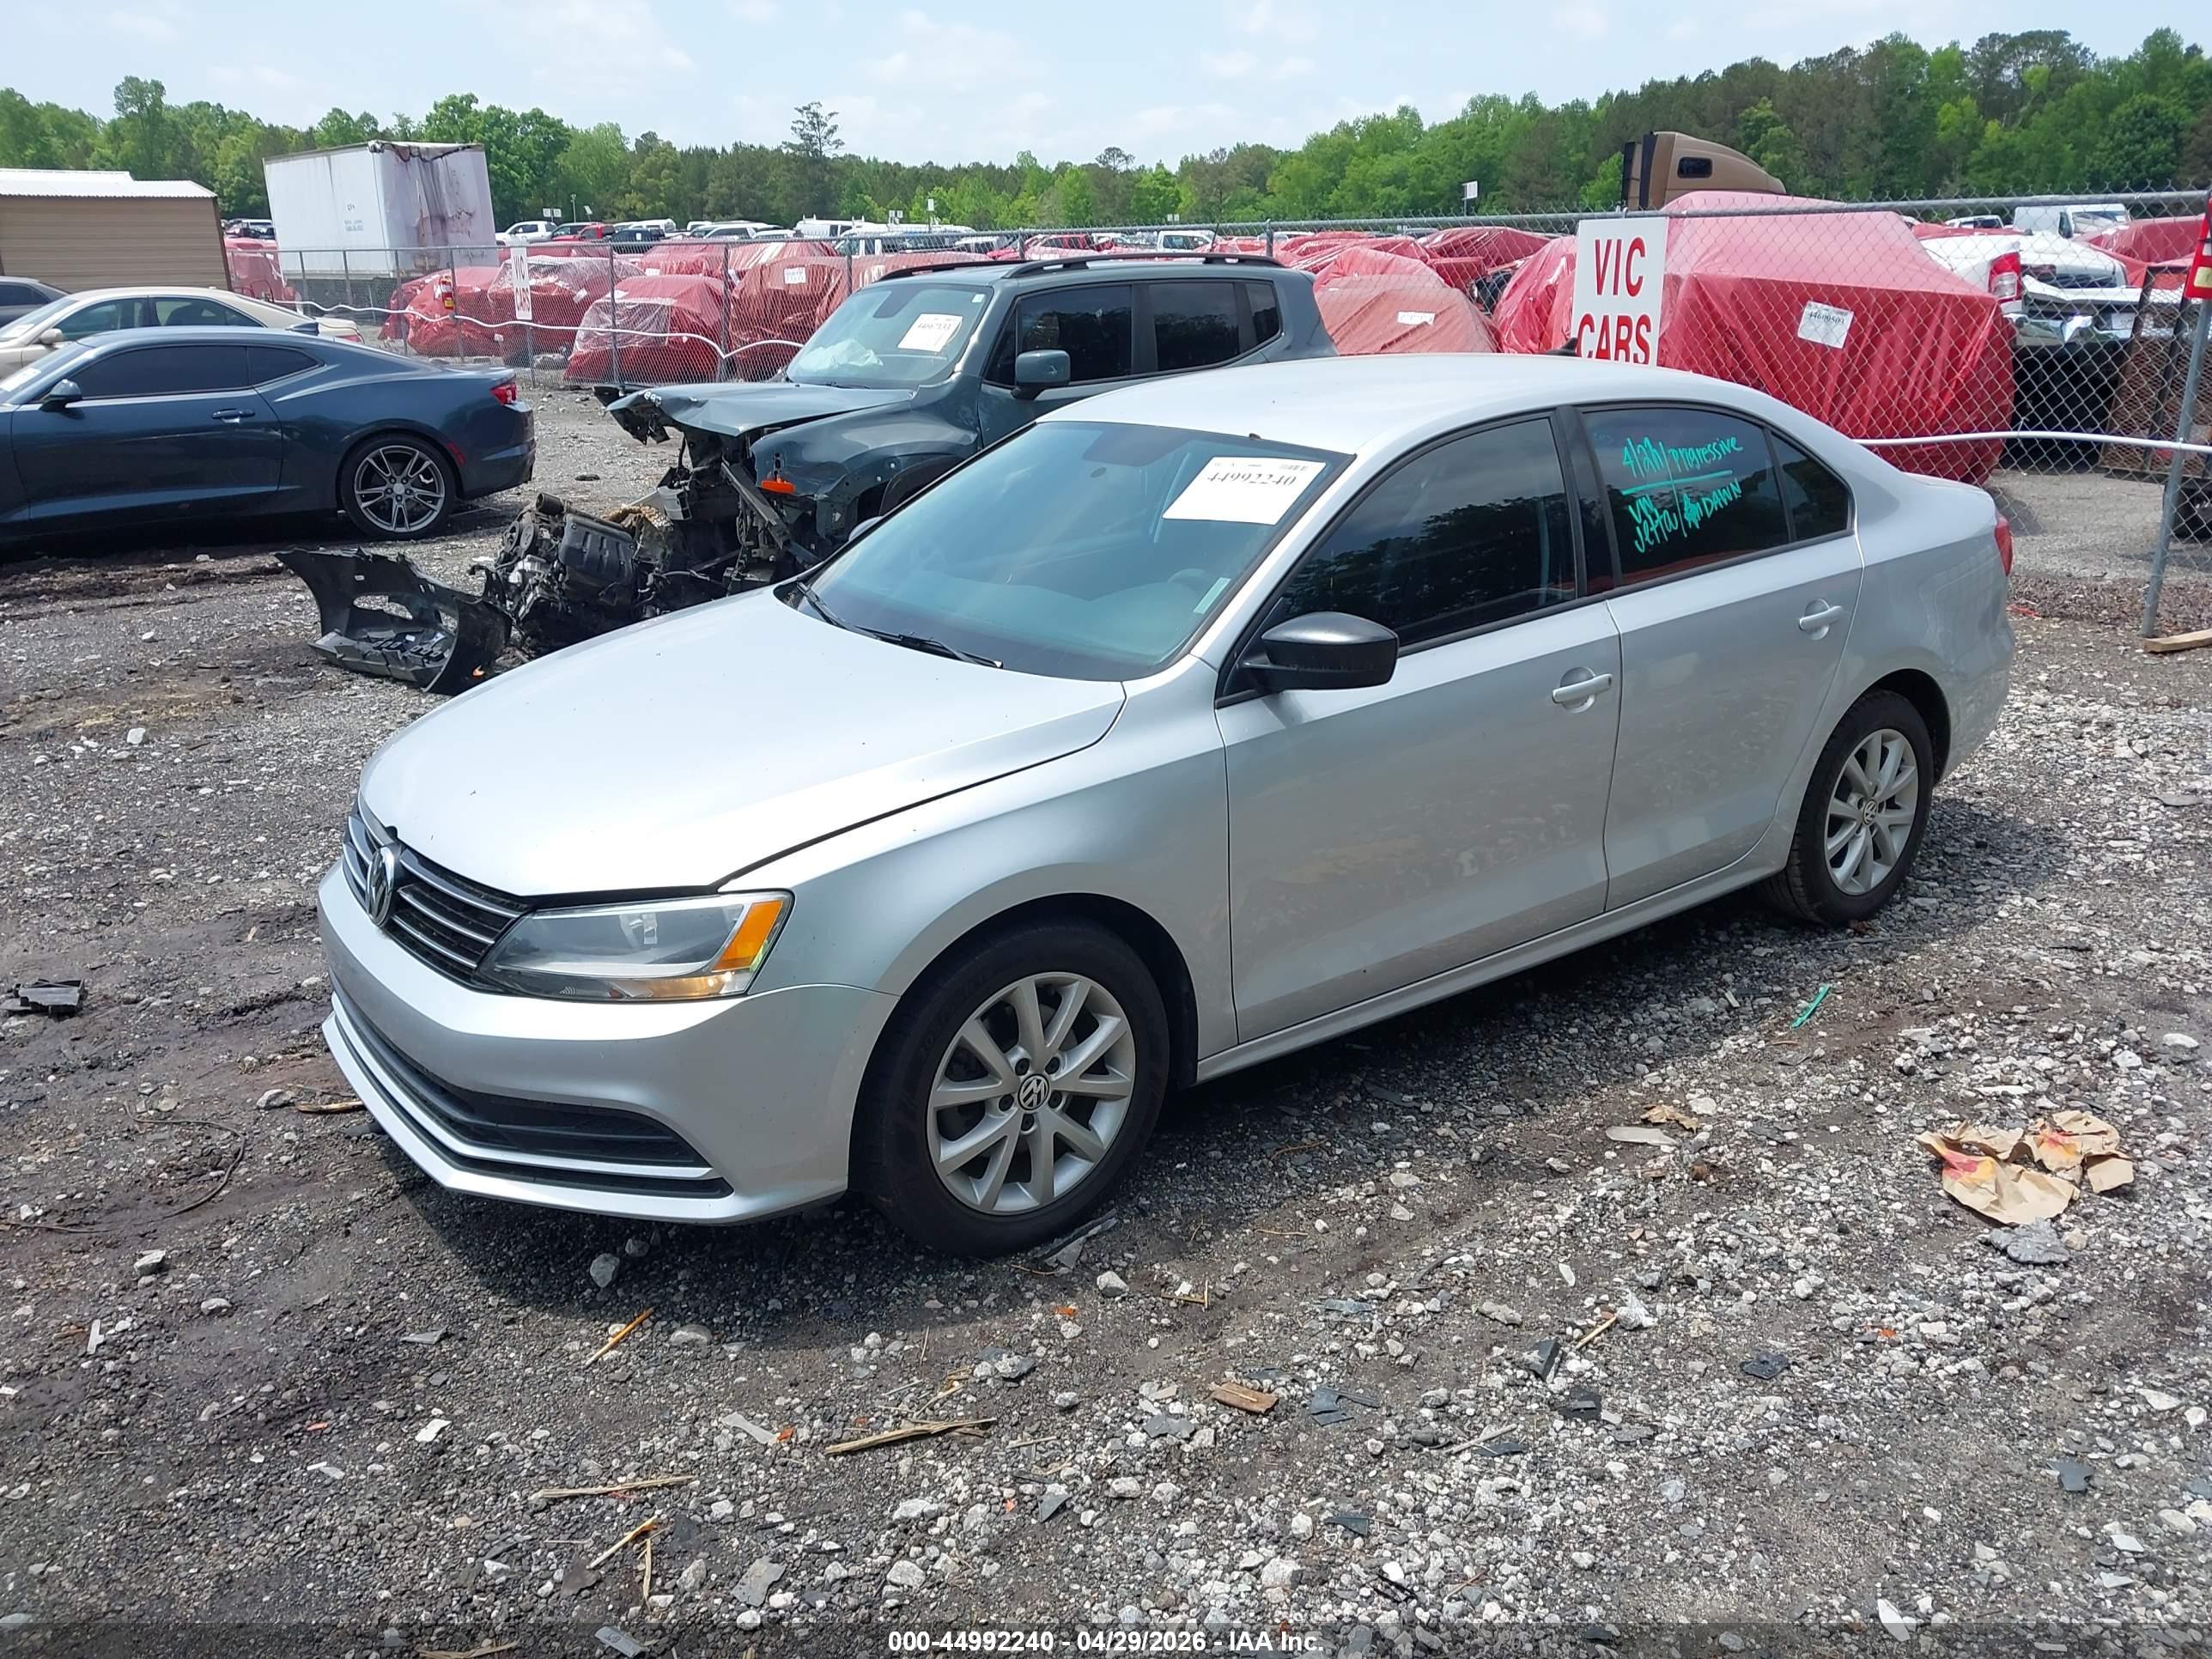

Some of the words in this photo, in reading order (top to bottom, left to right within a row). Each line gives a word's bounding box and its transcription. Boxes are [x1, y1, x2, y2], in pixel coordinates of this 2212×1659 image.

[1595, 237, 1646, 297] VIC
[1577, 313, 1652, 365] CARS
[1206, 471, 1297, 486] 44992240
